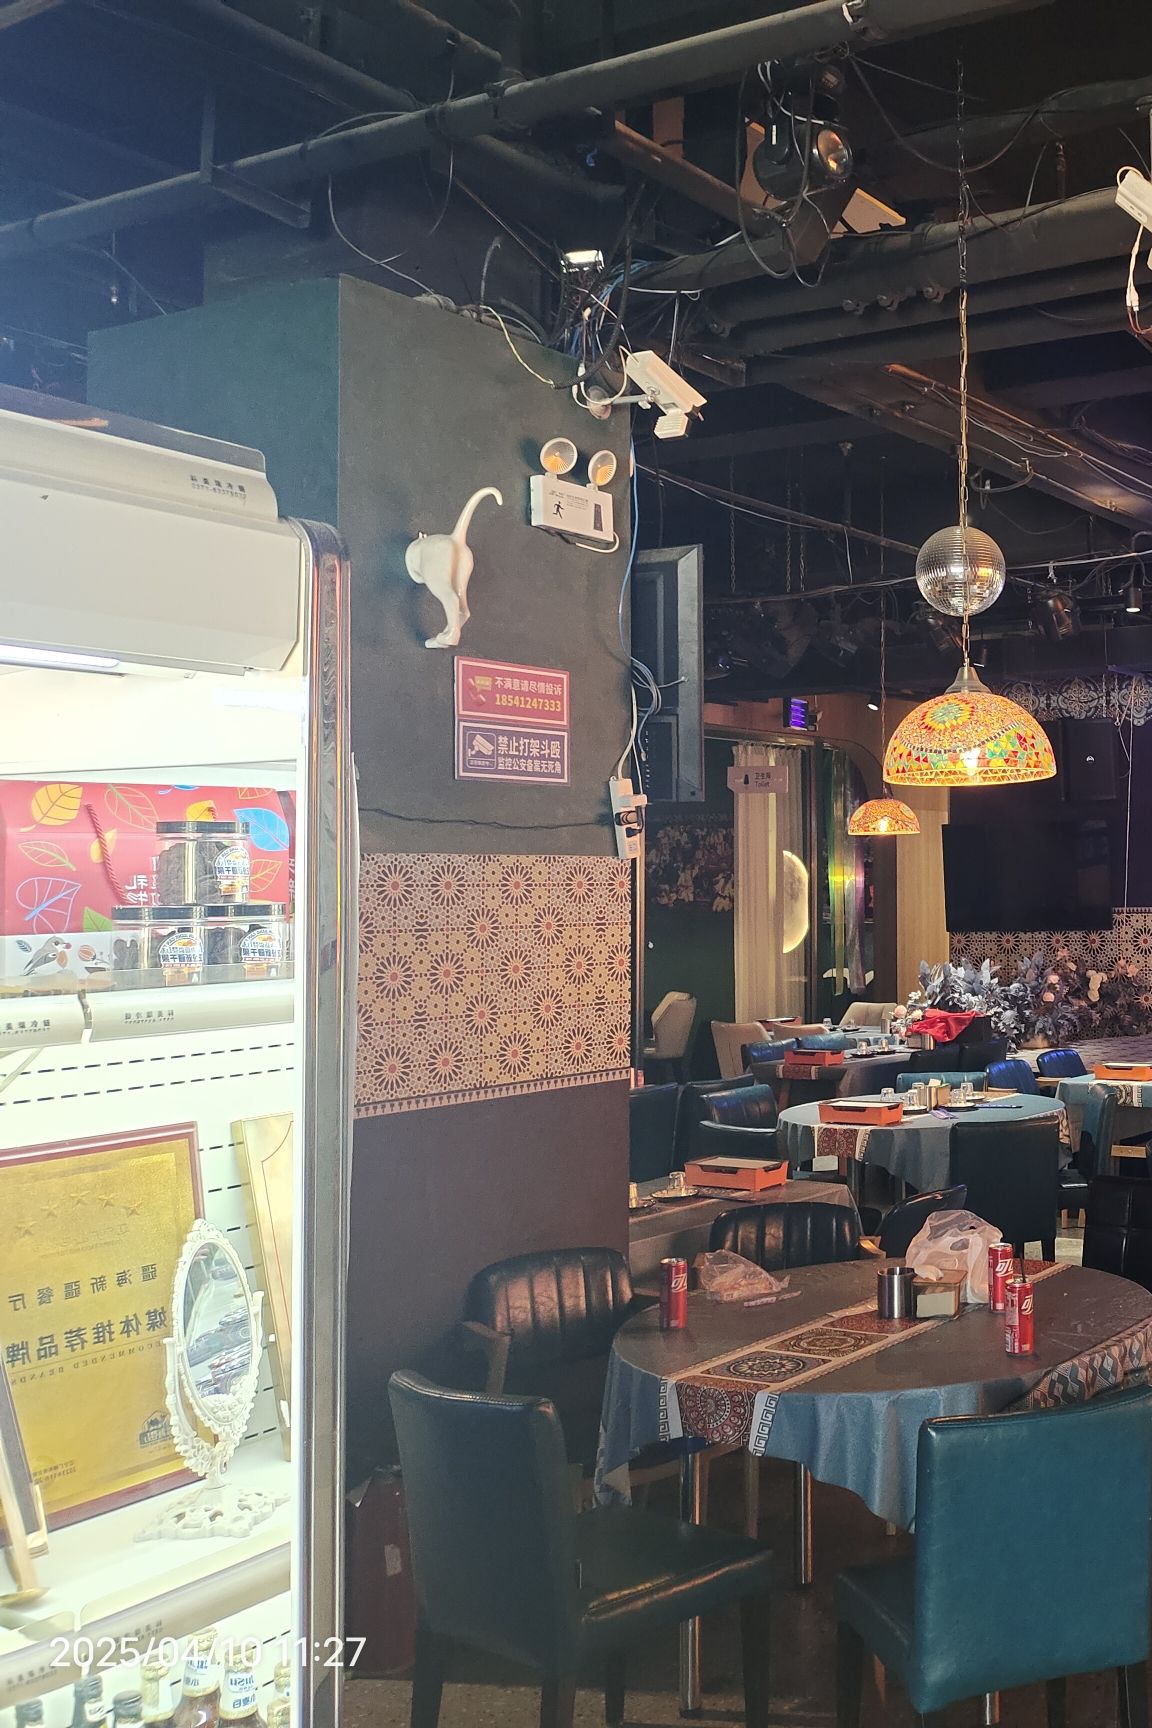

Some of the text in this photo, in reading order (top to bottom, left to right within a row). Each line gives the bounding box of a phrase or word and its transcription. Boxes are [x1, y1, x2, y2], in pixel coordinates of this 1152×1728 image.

[495, 677, 562, 696] 不满意请尽情投诉
[495, 694, 562, 712] 18541247333
[497, 735, 561, 759] 禁止打架斗殴
[497, 758, 562, 774] 监控公安备案无死角
